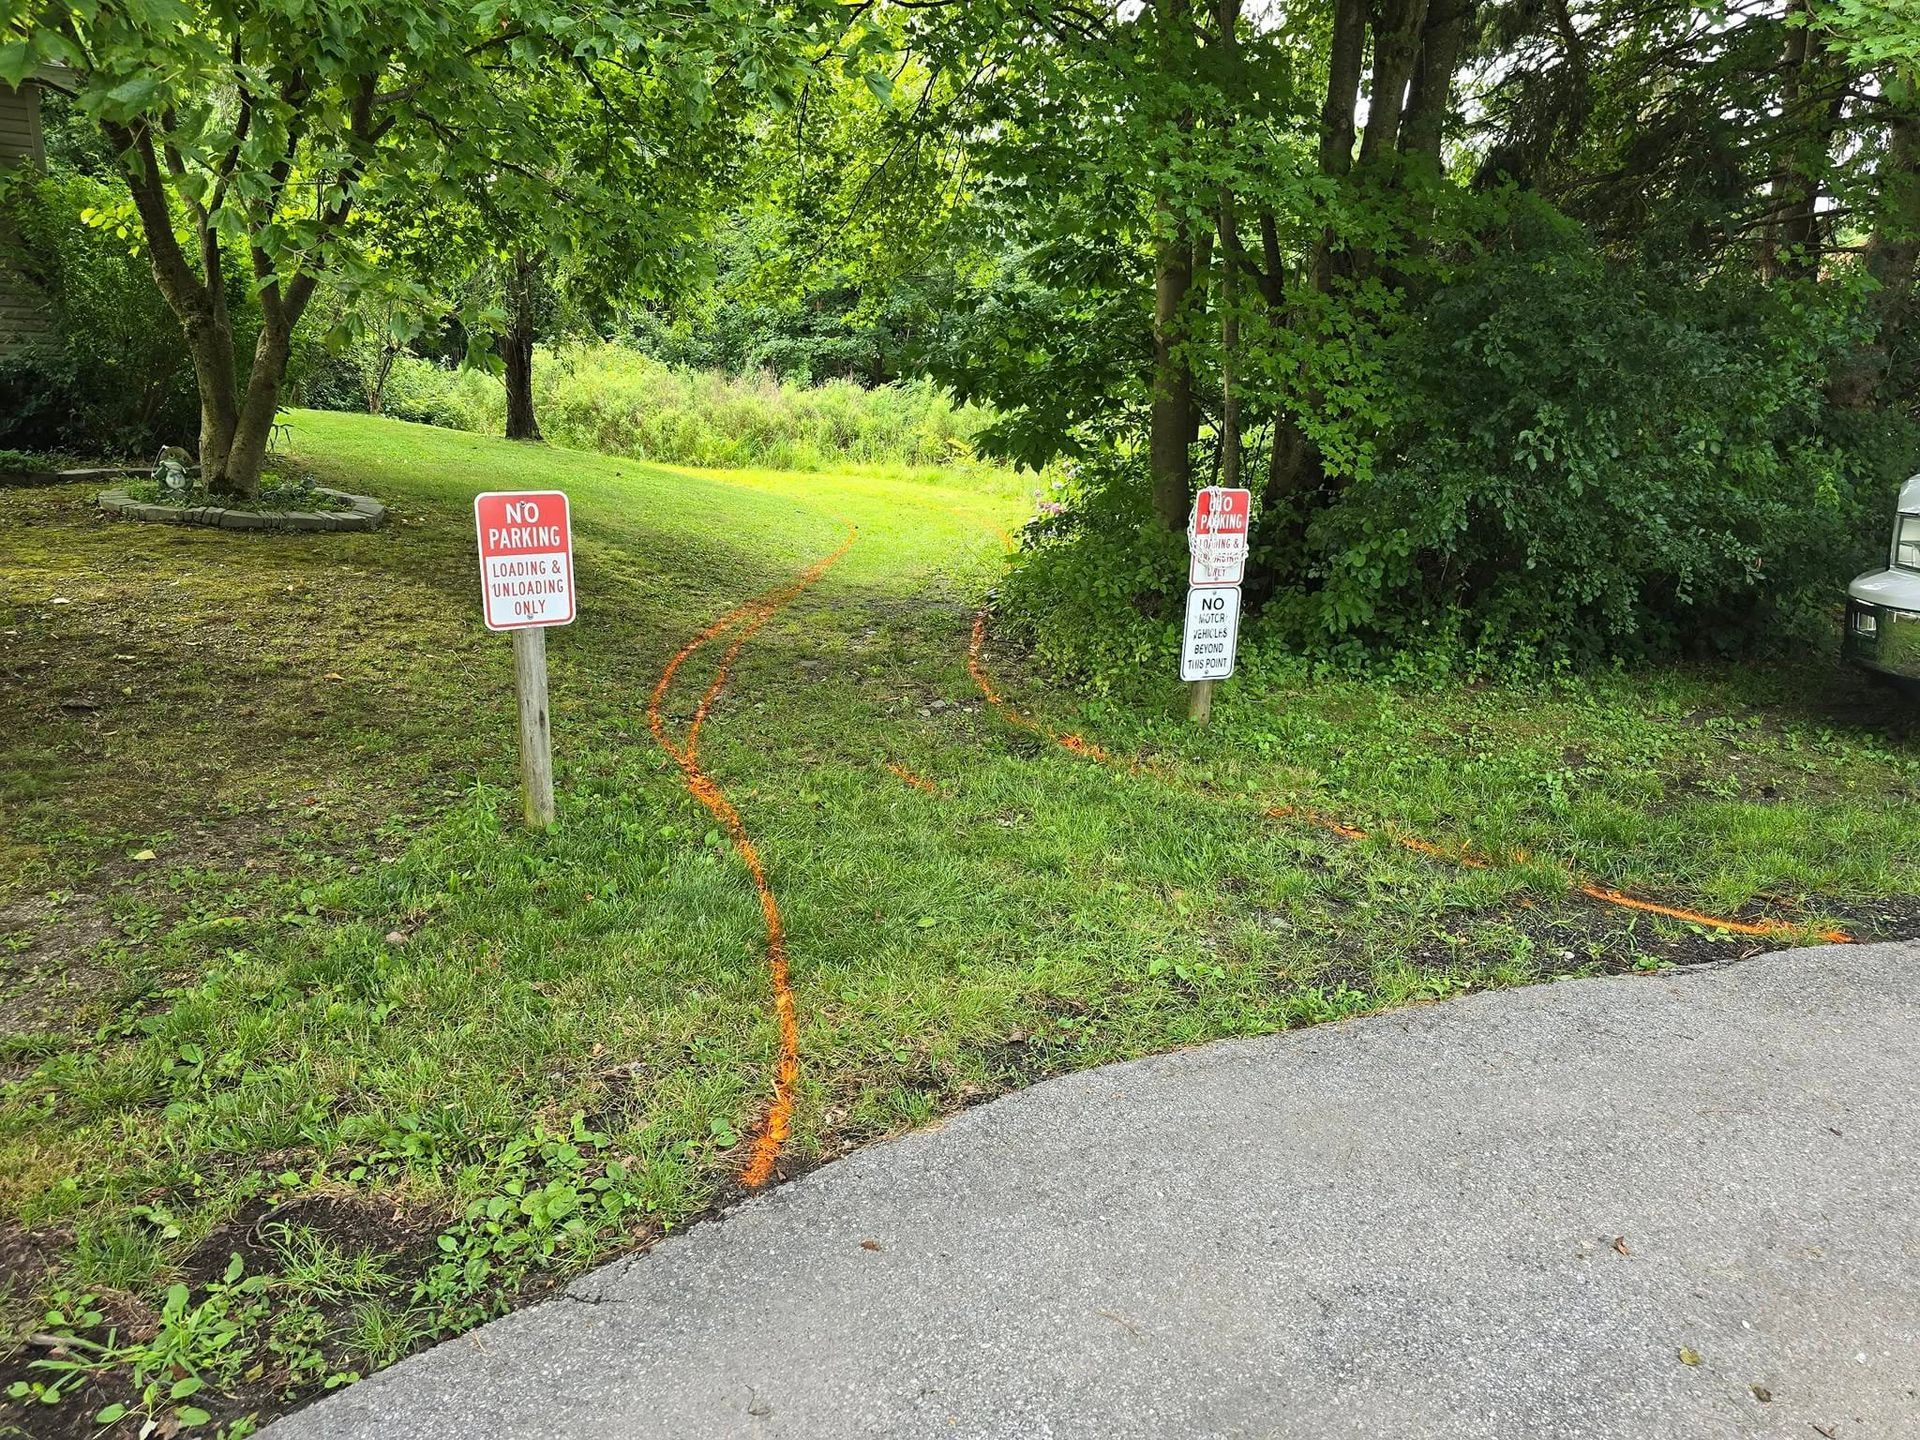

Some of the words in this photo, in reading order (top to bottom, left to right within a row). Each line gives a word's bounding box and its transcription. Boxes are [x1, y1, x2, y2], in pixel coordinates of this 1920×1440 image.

[505, 501, 540, 524] NO
[1211, 496, 1233, 512] O
[1200, 513, 1243, 530] PAKING
[488, 526, 561, 550] PARKING
[492, 560, 546, 578] LOADING
[551, 559, 561, 574] &
[492, 579, 564, 597] UNLOADING
[514, 599, 546, 616] ONLY
[1201, 597, 1225, 611] NO
[1194, 643, 1224, 654] BEYOND
[1205, 657, 1228, 669] POINT
